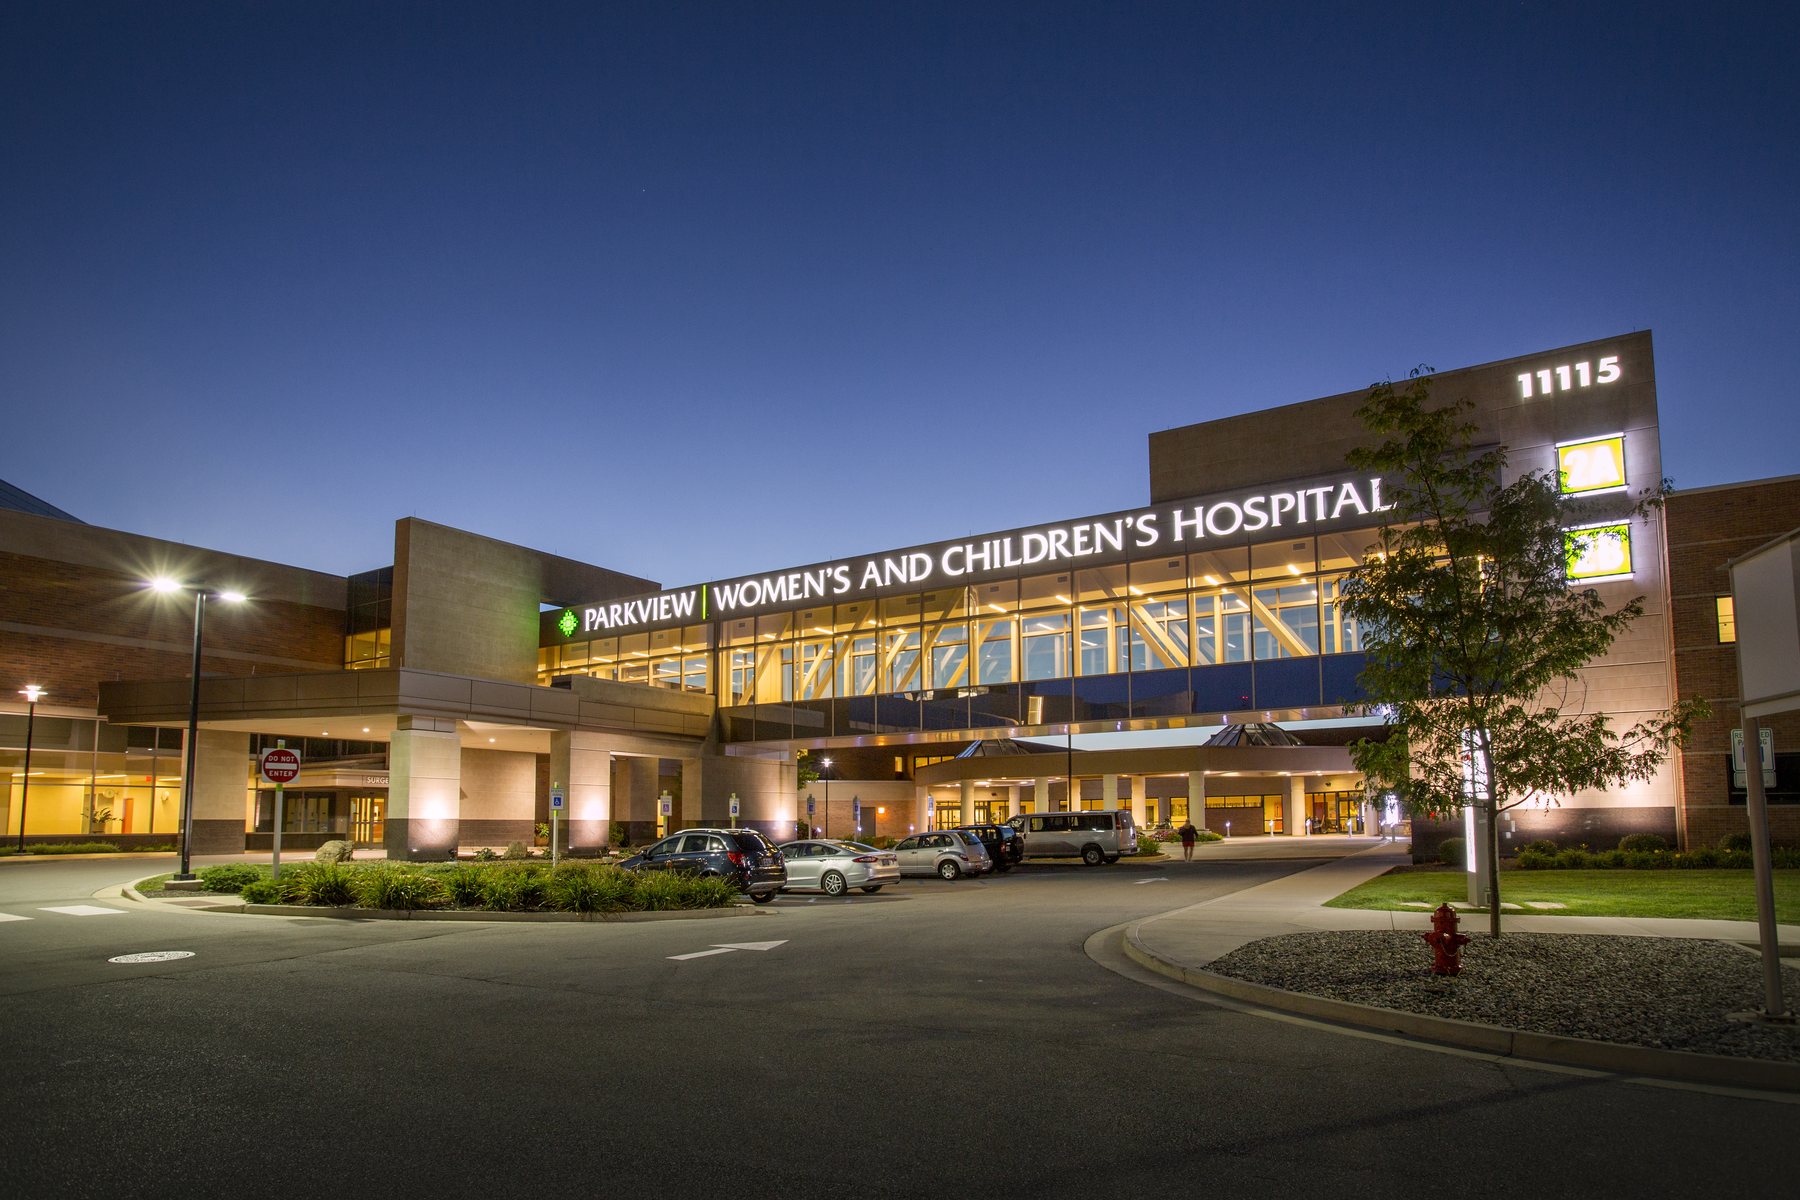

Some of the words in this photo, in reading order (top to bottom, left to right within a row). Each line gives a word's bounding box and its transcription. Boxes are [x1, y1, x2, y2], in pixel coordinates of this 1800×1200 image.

[1517, 356, 1621, 398] 11115
[1563, 445, 1620, 488] 2A
[584, 590, 697, 632] PARKVIEW
[713, 565, 852, 611] WOMEN'S
[859, 552, 933, 590] AND
[940, 514, 1159, 576] CHILDREN'S
[1173, 477, 1398, 542] HOSPITAL
